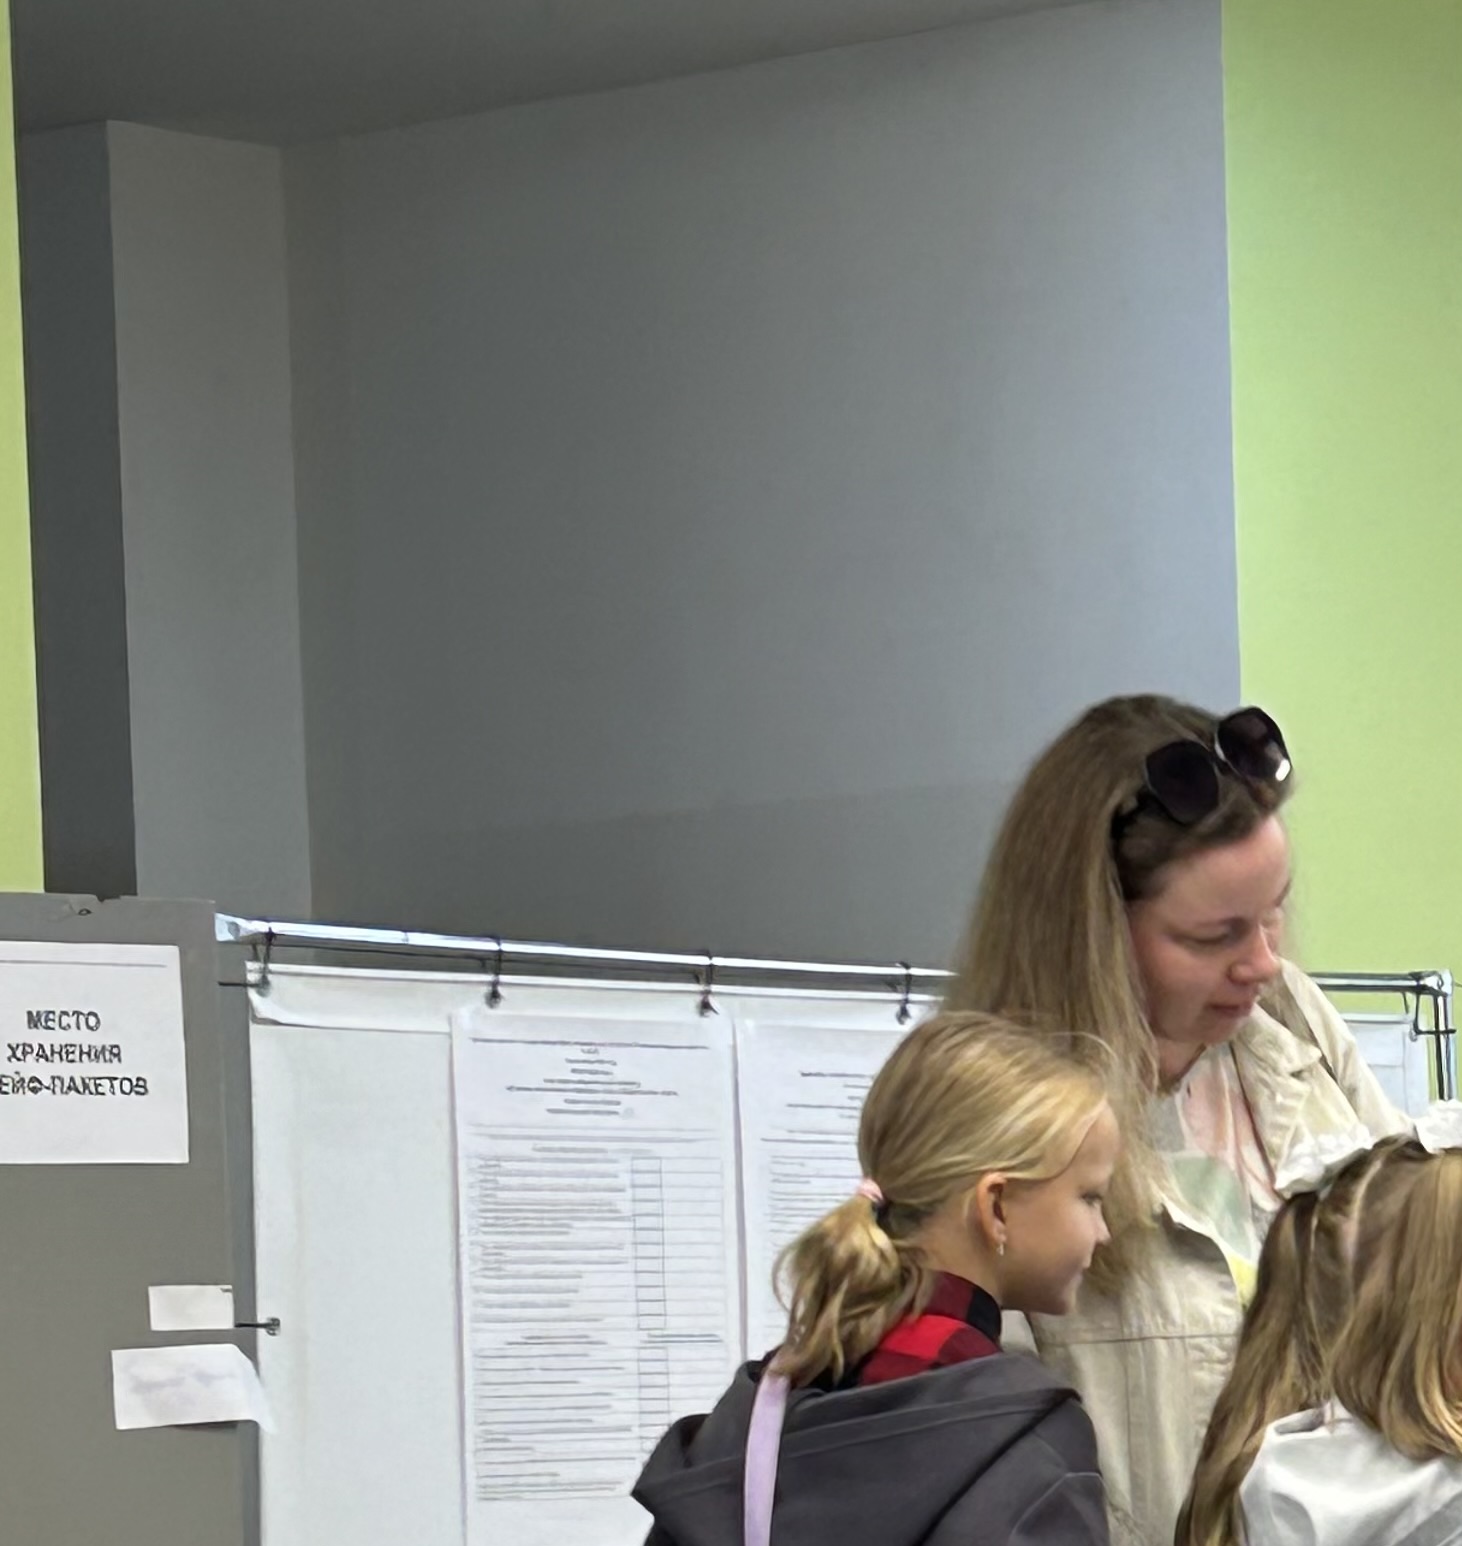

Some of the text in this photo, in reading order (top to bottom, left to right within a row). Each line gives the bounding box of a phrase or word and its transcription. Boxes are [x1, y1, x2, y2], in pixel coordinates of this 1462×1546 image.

[27, 1010, 101, 1031] МЕСТО
[7, 1042, 122, 1063] ХРАНЕНИЯ
[0, 1071, 149, 1096] ЕЙФ-ПАКЕТОВ
